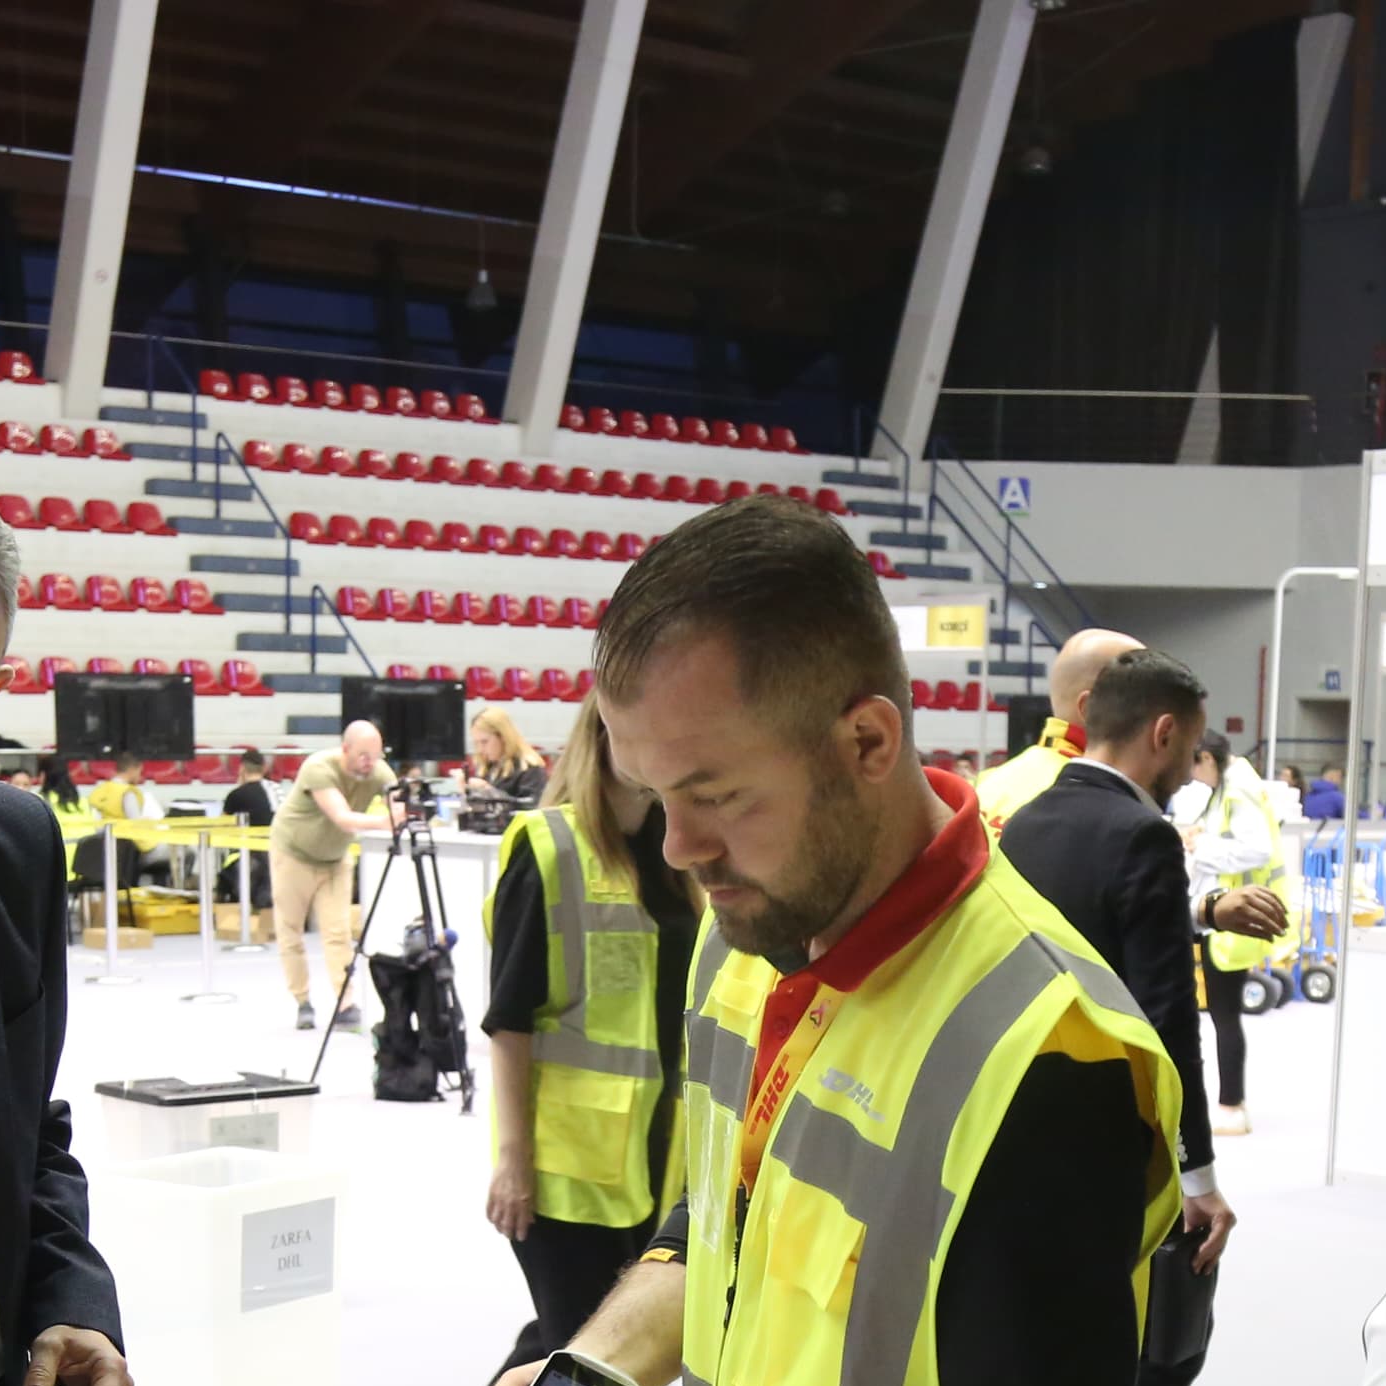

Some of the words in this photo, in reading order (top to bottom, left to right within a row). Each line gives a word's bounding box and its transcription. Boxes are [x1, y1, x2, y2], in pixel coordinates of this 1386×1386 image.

[756, 1064, 790, 1126] DHL
[821, 1067, 877, 1115] DHL
[270, 1229, 312, 1250] ZARFA
[277, 1254, 303, 1272] DHL
